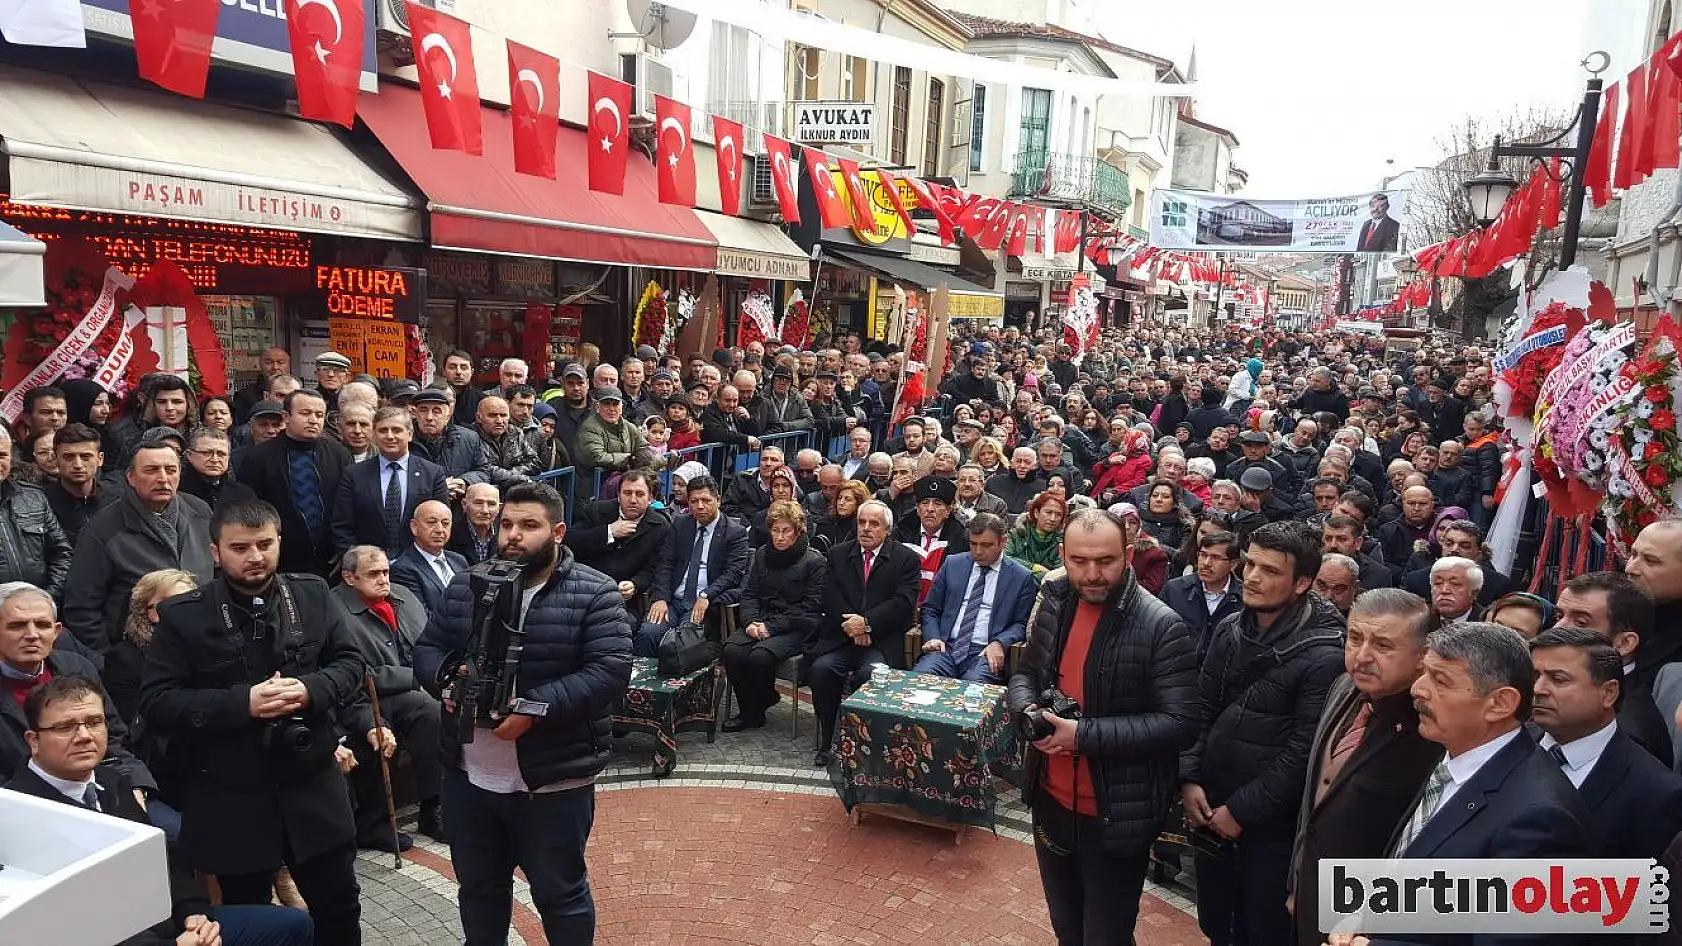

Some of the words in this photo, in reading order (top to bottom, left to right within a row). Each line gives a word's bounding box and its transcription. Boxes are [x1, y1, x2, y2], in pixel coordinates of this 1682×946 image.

[799, 109, 872, 125] AVUKAT
[801, 127, 836, 140] İLKNUR
[839, 128, 870, 140] AYDIN
[128, 180, 204, 208] PAŞAM
[238, 190, 323, 221] İLETİŞİM
[765, 260, 799, 276] ADNAN
[1028, 269, 1044, 278] ECE
[317, 265, 408, 296] FATURA
[327, 289, 394, 319] ÖDEME
[370, 324, 400, 337] EKRAN
[374, 350, 399, 363] CAM
